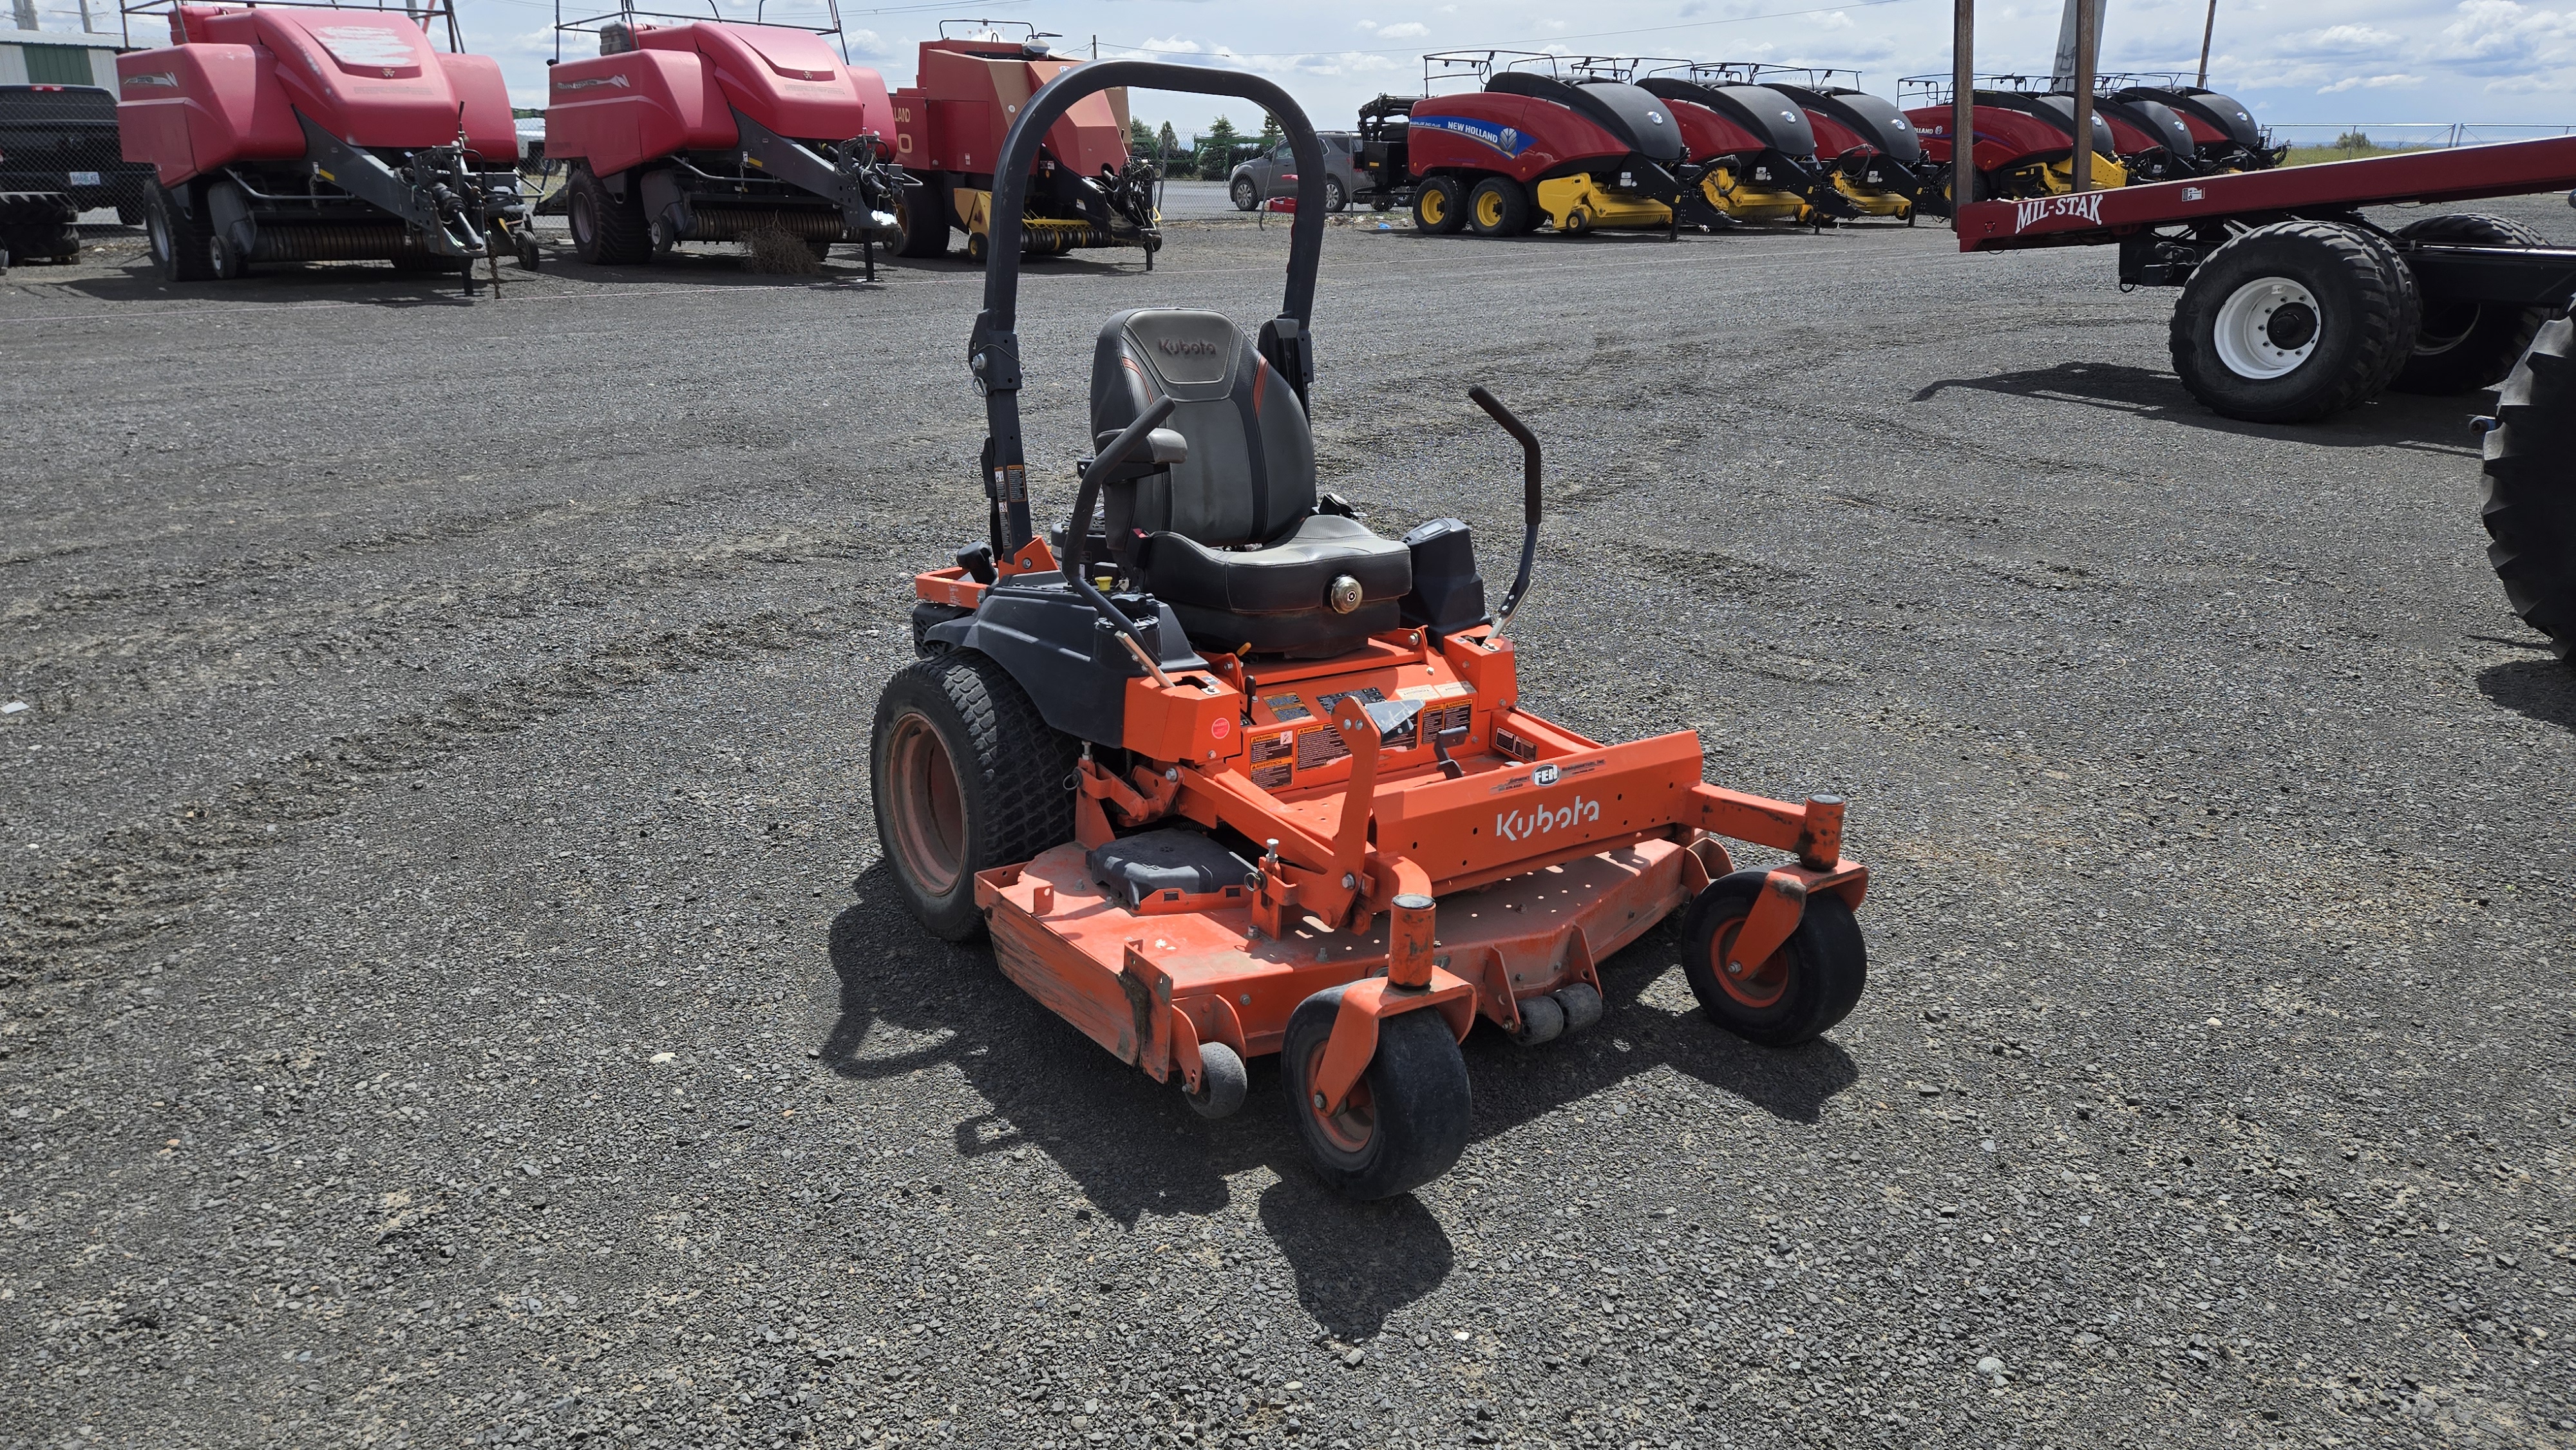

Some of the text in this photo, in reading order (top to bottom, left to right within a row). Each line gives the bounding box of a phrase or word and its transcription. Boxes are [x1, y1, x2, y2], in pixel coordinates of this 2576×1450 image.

[894, 107, 911, 122] LAND
[1448, 121, 1498, 143] NEW HOLLAND
[2015, 194, 2103, 234] MIL-STAK
[1157, 339, 1217, 355] Kubota
[1535, 764, 1558, 786] FEH
[1496, 795, 1600, 841] Kubota
